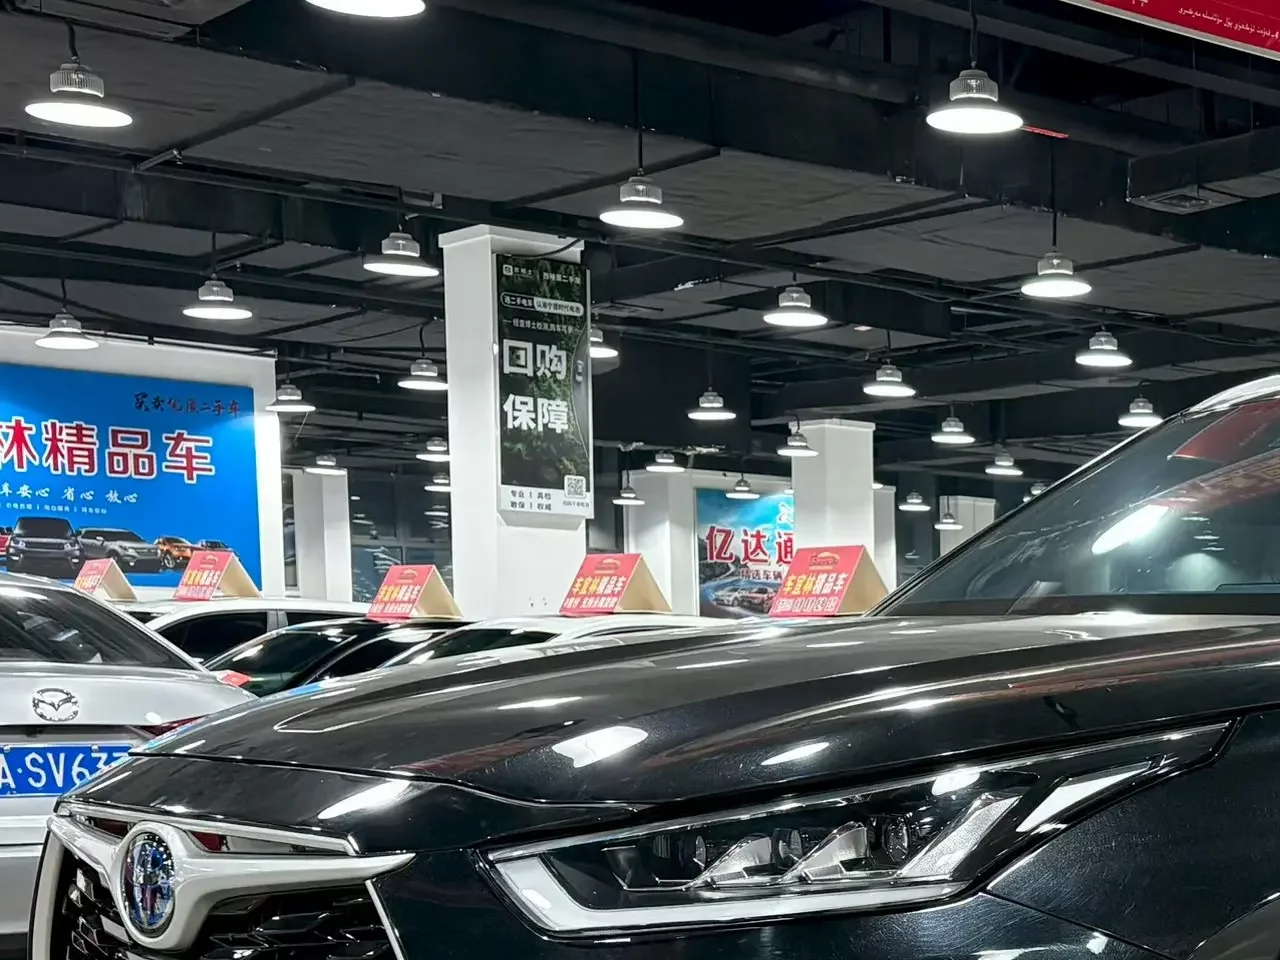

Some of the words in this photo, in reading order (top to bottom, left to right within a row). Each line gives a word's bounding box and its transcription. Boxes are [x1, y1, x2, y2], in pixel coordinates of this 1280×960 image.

[503, 339, 567, 379] 回购
[503, 393, 569, 433] 保障
[0, 416, 216, 484] 林精品车
[62, 486, 95, 502] 省心
[105, 489, 138, 504] 放心
